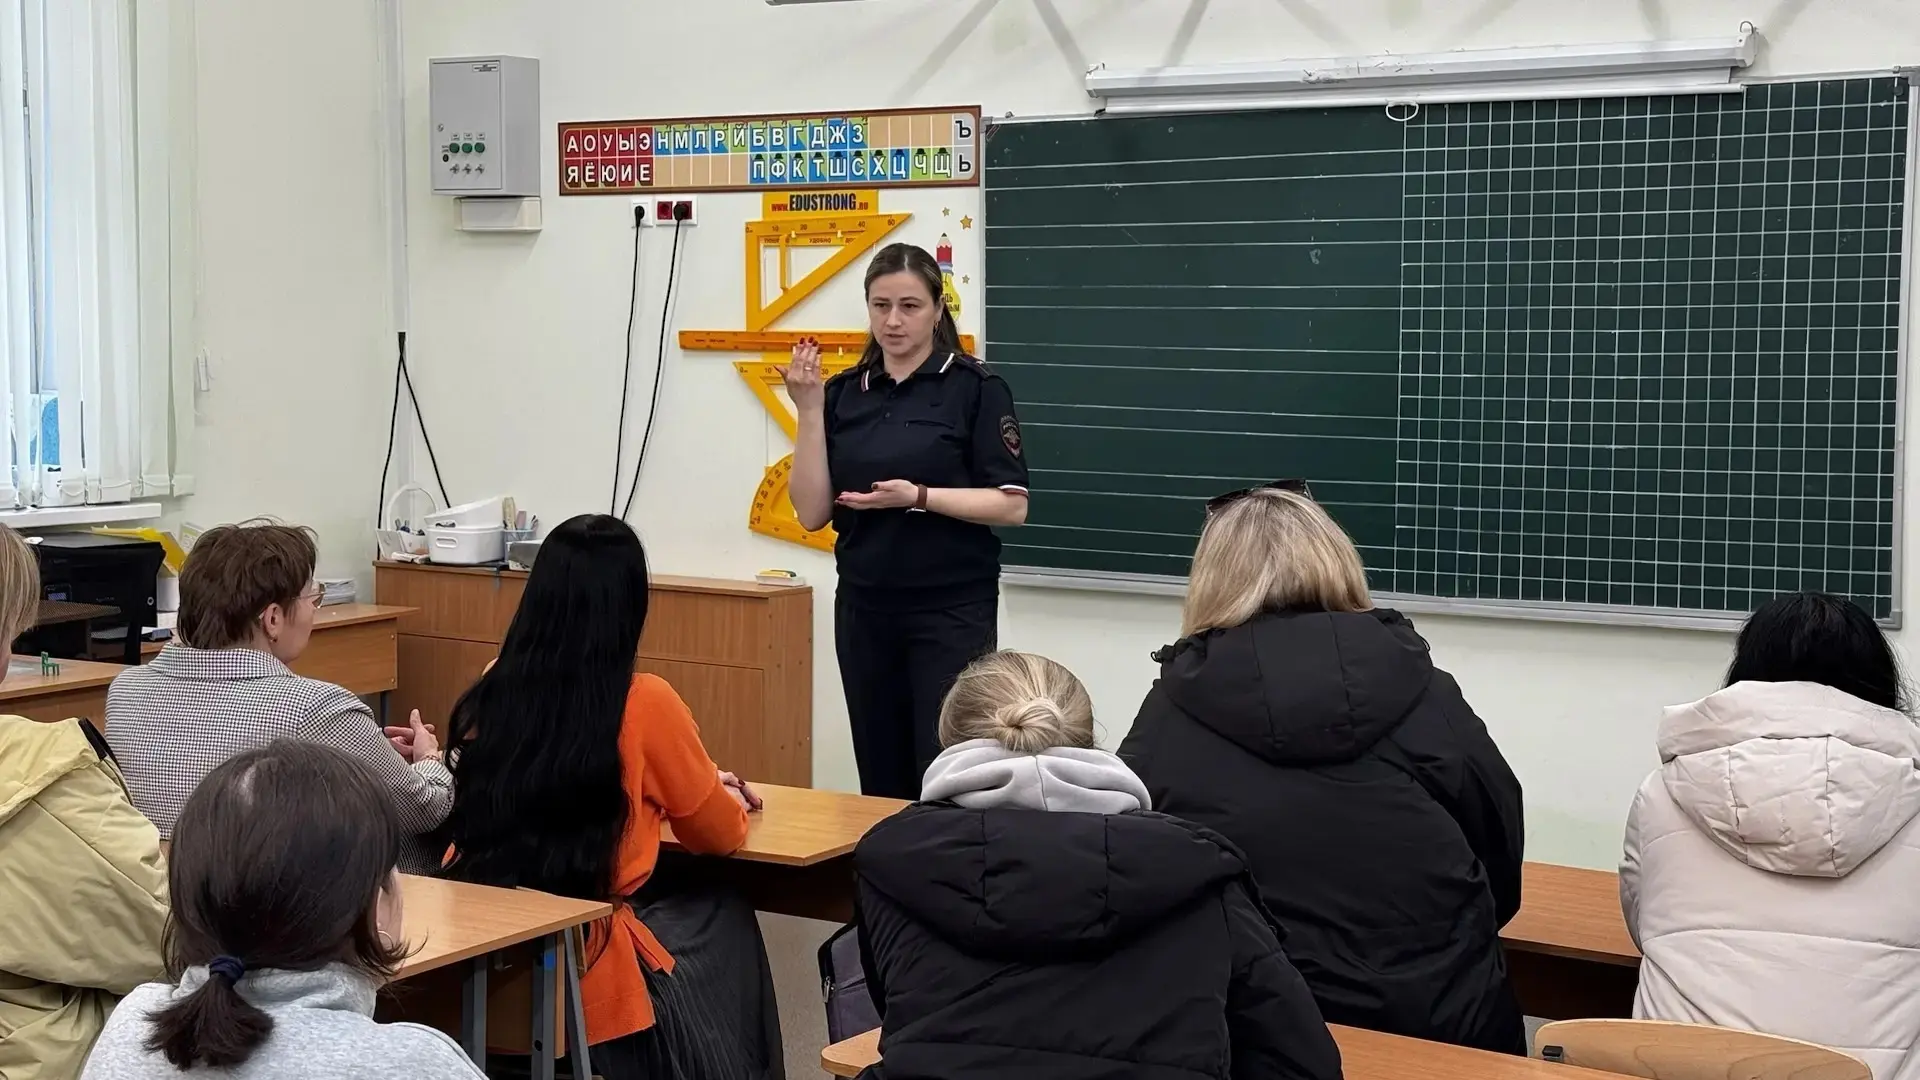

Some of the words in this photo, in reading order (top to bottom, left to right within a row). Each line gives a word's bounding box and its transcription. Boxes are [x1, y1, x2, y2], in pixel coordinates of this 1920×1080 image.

[566, 136, 579, 153] А
[584, 134, 596, 152] О
[602, 134, 613, 152] У
[618, 134, 634, 152] Ы
[639, 132, 650, 150] Э
[657, 132, 669, 150] Н
[675, 132, 688, 150] М
[694, 130, 706, 149] Л
[714, 130, 726, 148] Р
[733, 124, 746, 148] Й
[752, 128, 765, 147] Б
[772, 128, 784, 146] В
[793, 127, 803, 146] Г
[811, 126, 826, 148] Д
[829, 125, 846, 144] Ж
[852, 124, 864, 144] З
[955, 120, 972, 138] Ъ
[567, 166, 579, 183] Я
[585, 159, 596, 183] Ё
[602, 164, 616, 182] Ю
[622, 164, 632, 182] И
[640, 164, 650, 181] Е
[752, 160, 765, 179] П
[770, 160, 786, 178] Ф
[792, 160, 804, 178] К
[812, 158, 824, 178] Т
[830, 158, 847, 177] Ш
[851, 157, 864, 176] С
[872, 156, 886, 176] Х
[893, 156, 906, 179] Ц
[914, 156, 927, 175] Ч
[934, 155, 952, 178] Щ
[958, 154, 972, 173] Ь
[858, 220, 866, 228] 40
[821, 368, 828, 376] 30
